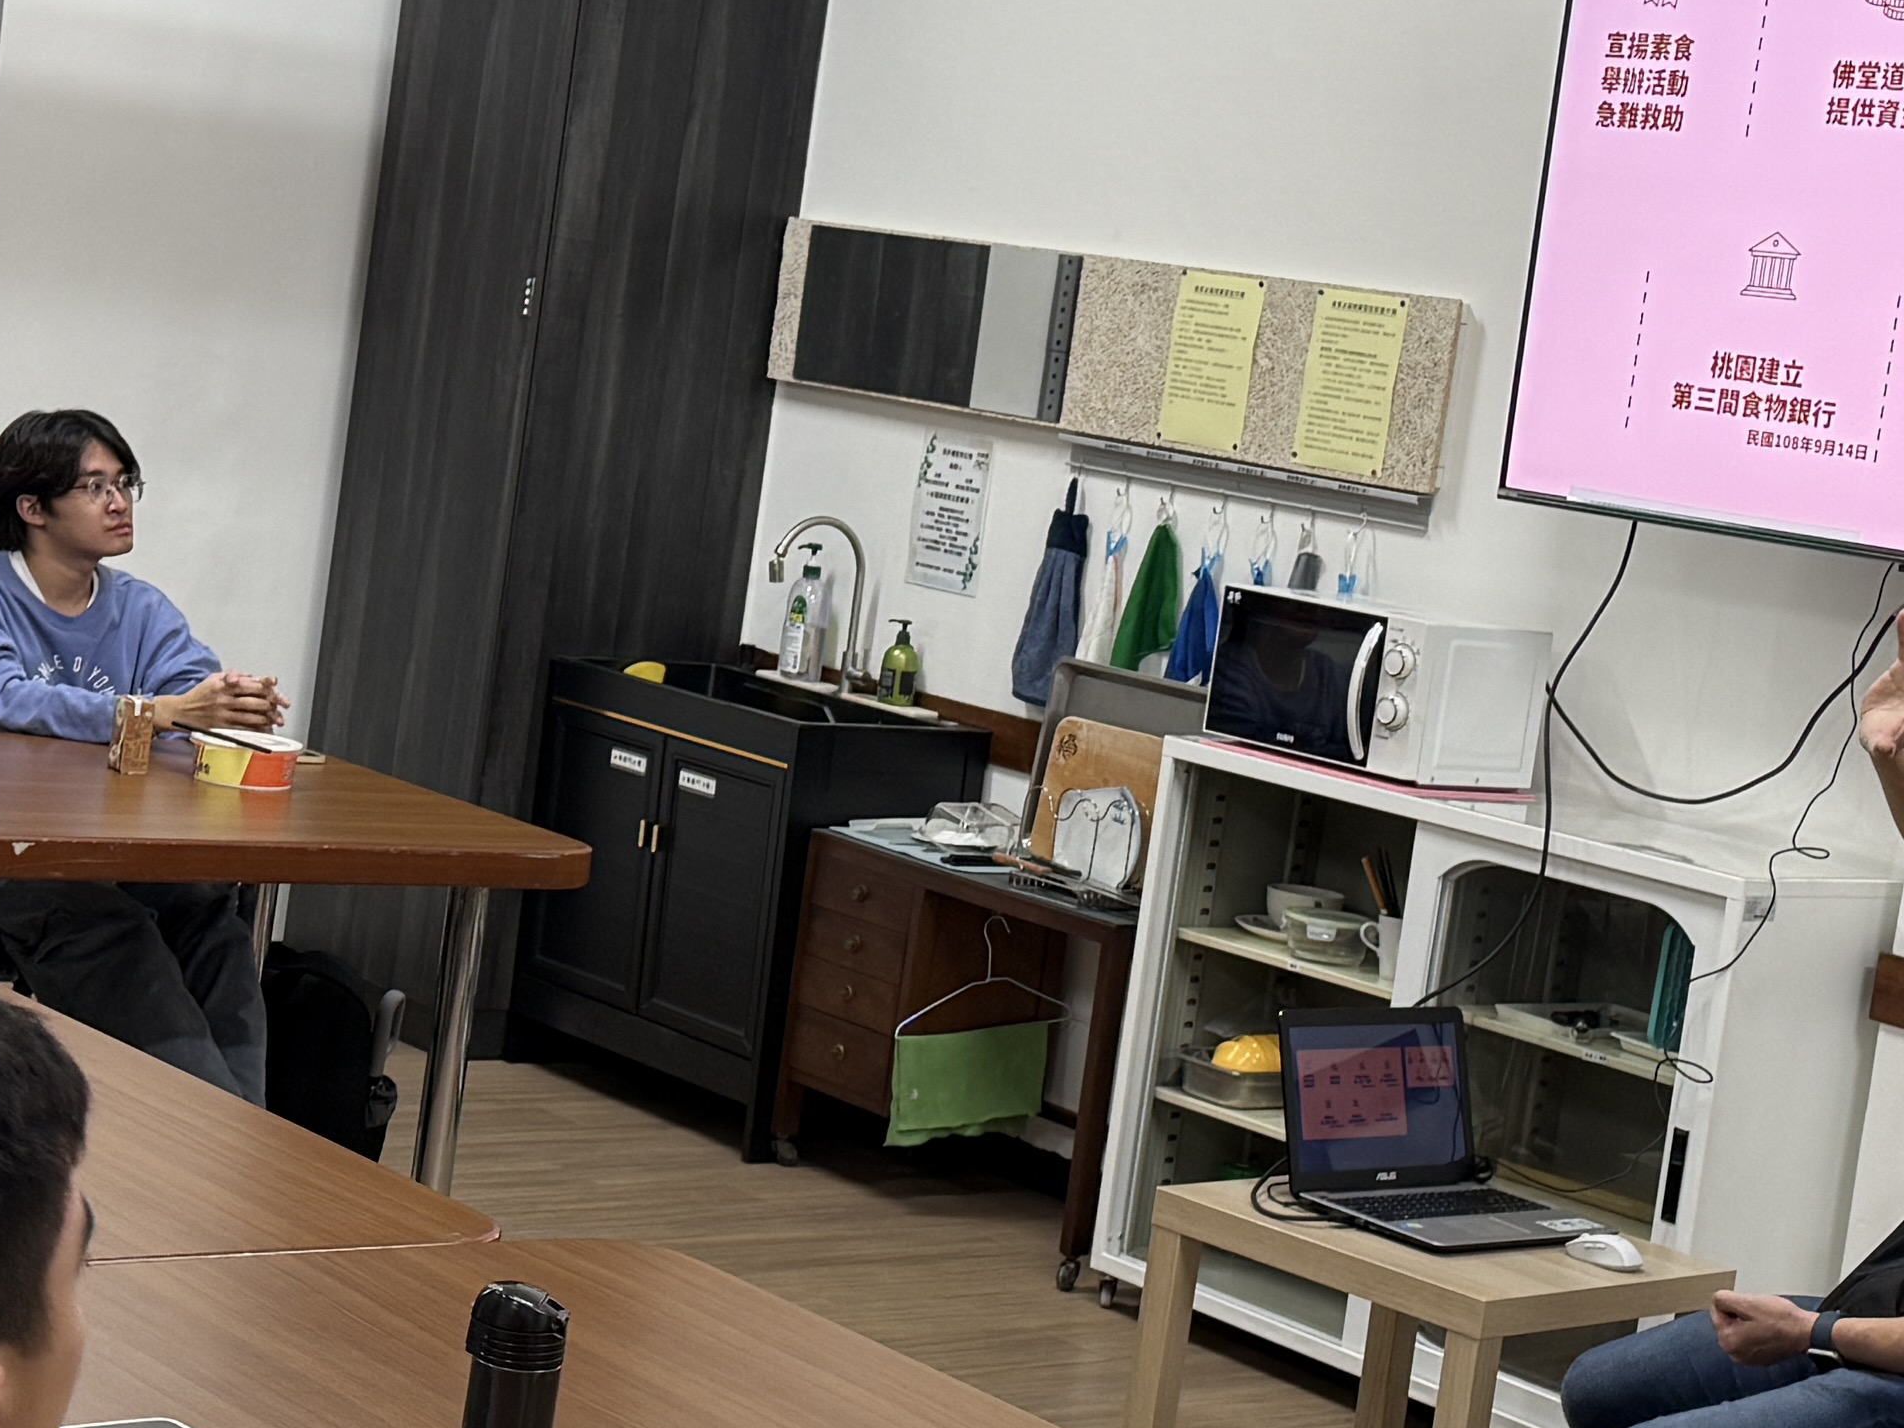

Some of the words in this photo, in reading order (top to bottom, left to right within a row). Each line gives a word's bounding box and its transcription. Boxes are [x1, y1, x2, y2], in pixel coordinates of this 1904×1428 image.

[1605, 32, 1695, 61] 宣揚素食
[1601, 67, 1689, 98] 舉辦活動
[1596, 100, 1684, 132] 急難救助
[1711, 350, 1804, 388] 桃園建立
[1672, 382, 1836, 429] 第三間食物銀行
[1747, 429, 1868, 460] 民國108年9月14日
